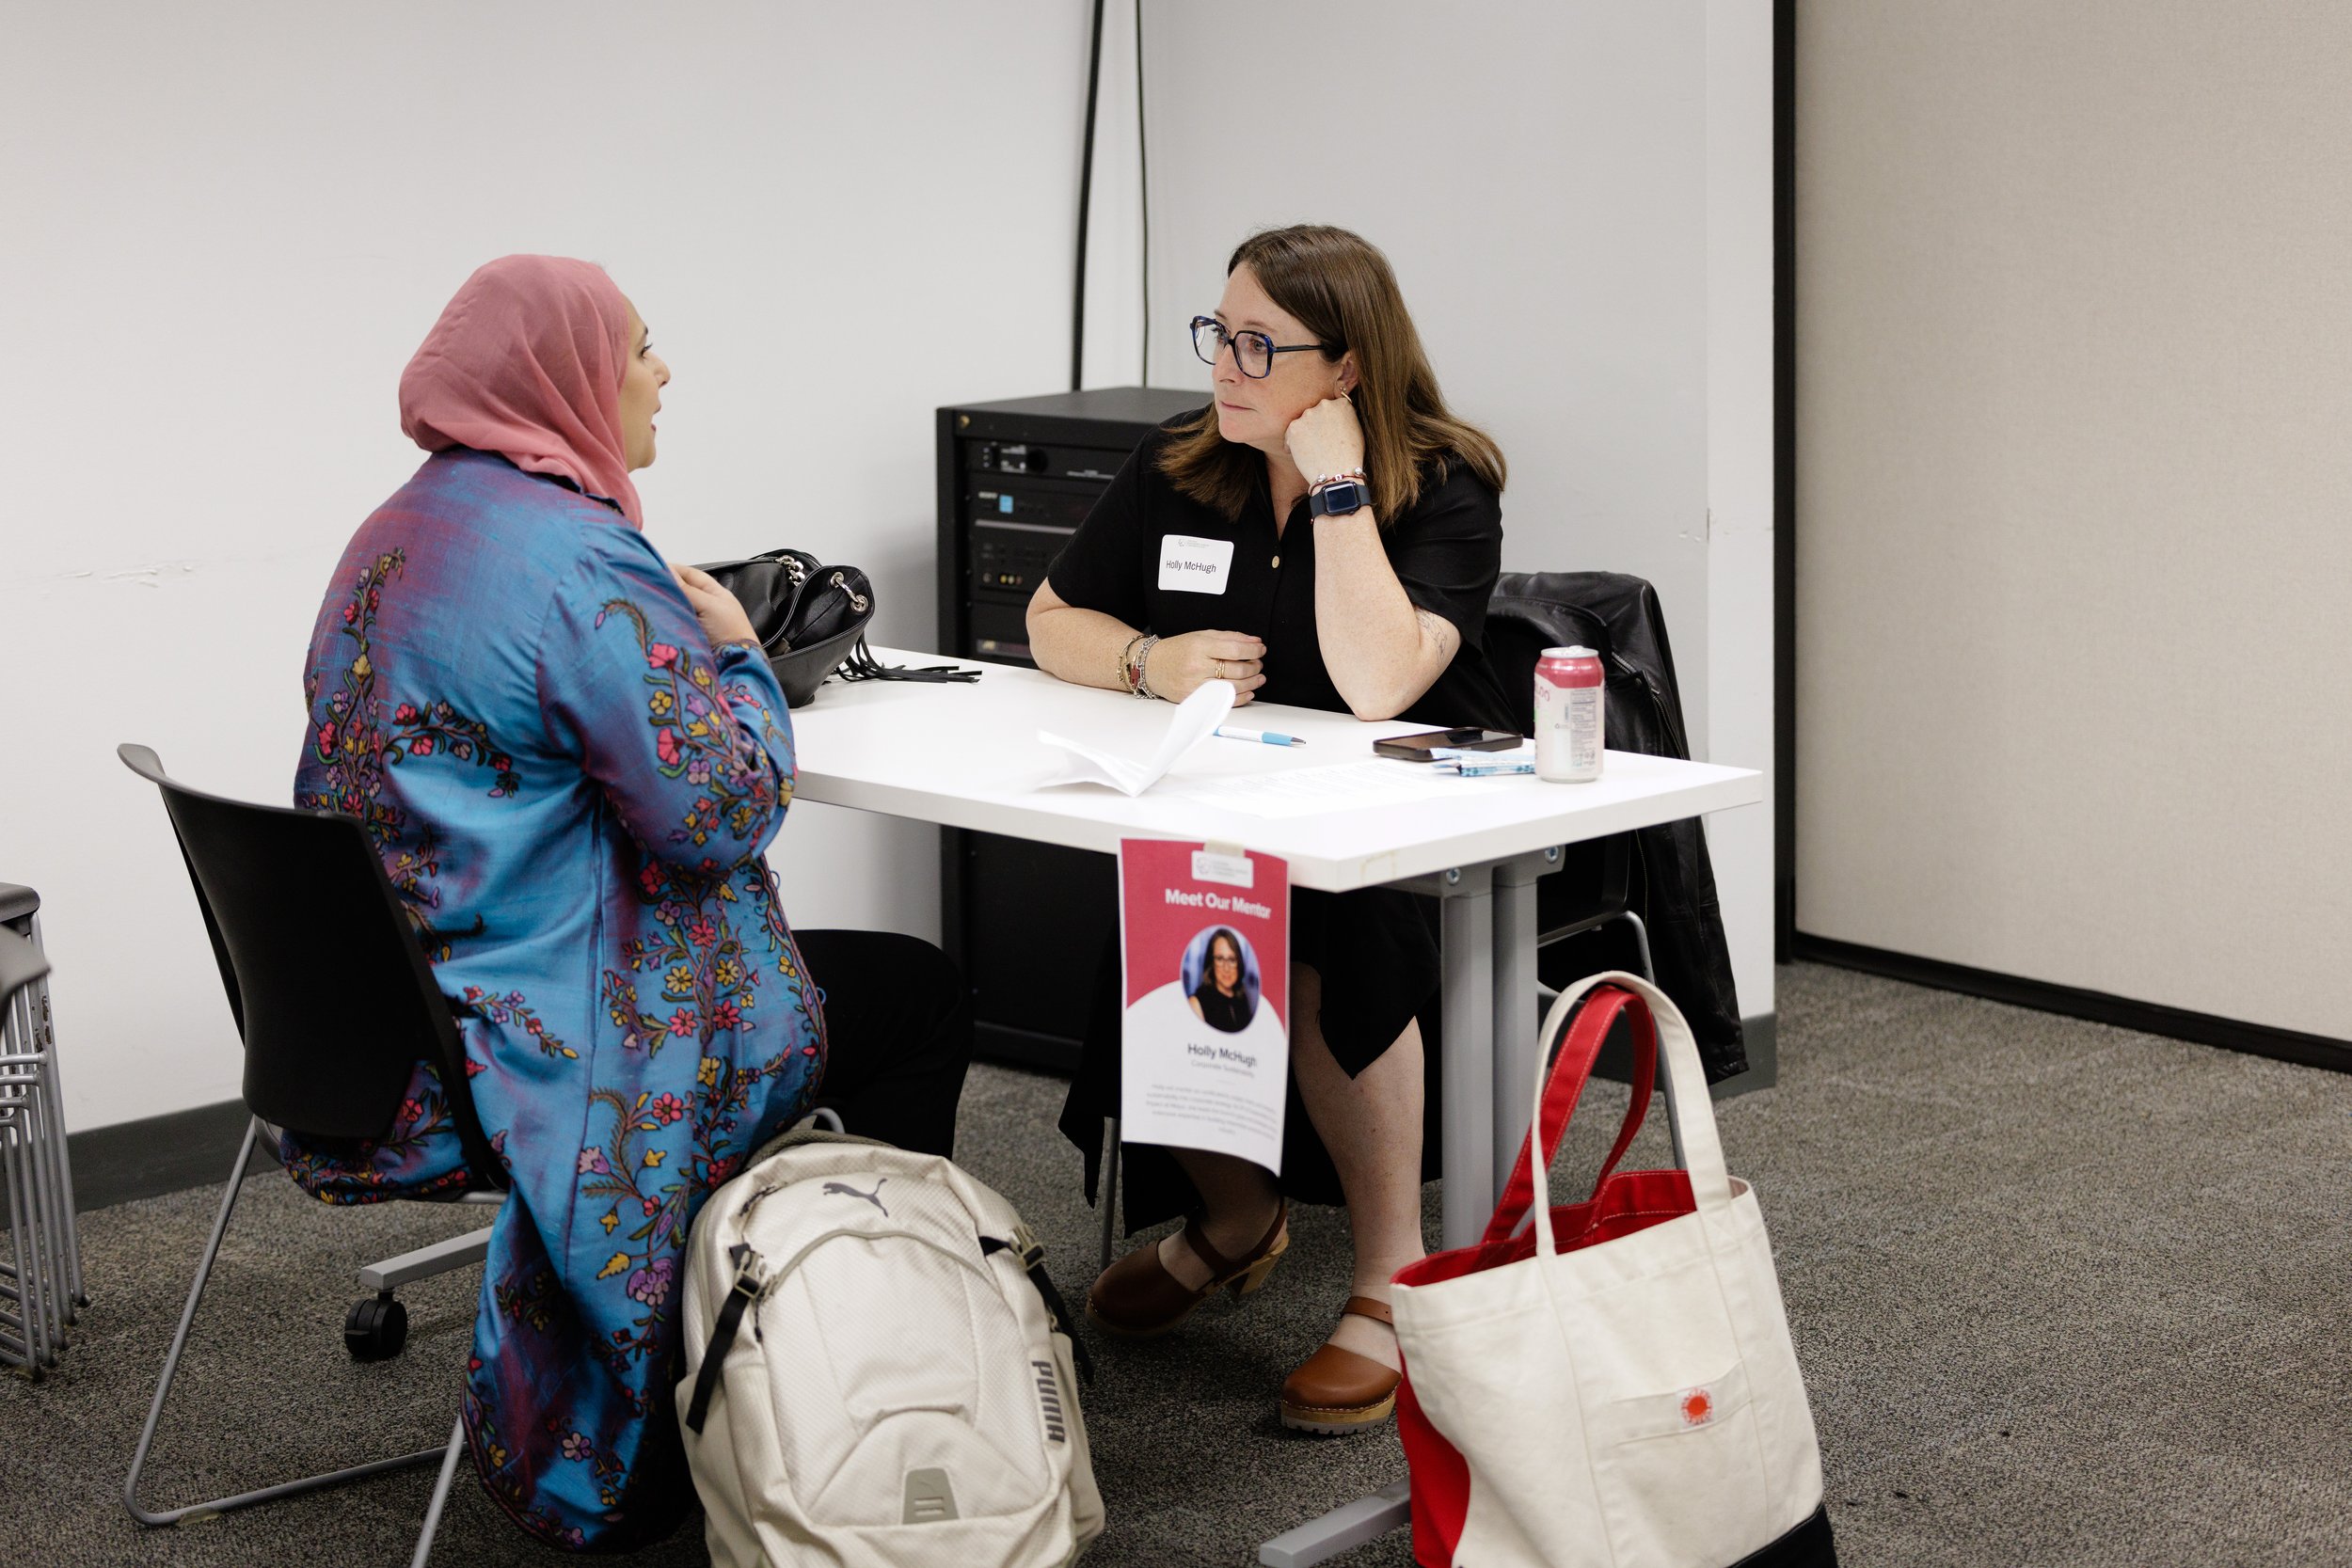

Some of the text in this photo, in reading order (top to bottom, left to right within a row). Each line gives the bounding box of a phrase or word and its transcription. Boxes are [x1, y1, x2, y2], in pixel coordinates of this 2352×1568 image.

[1166, 560, 1216, 574] Holly McHugh
[1166, 888, 1272, 920] Meet Our Mentor
[1187, 1043, 1257, 1068] Holly McHugh
[1031, 1360, 1066, 1443] PUMA
